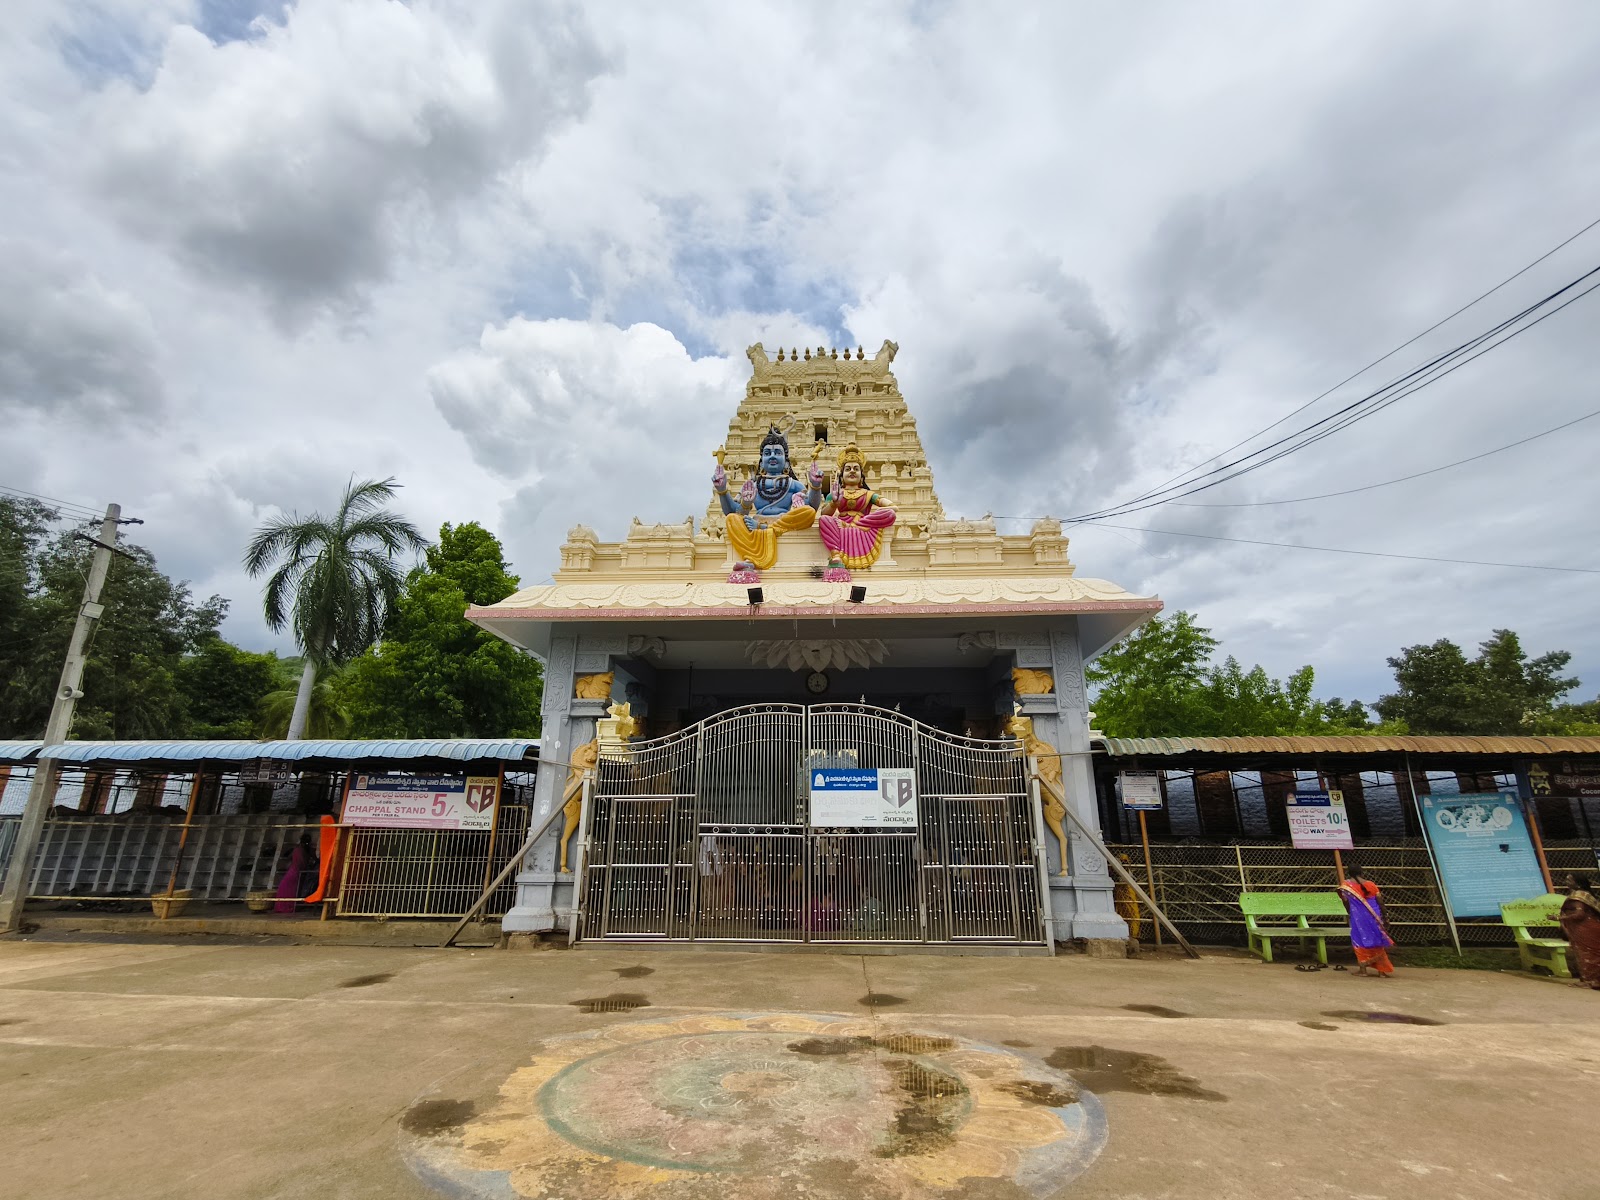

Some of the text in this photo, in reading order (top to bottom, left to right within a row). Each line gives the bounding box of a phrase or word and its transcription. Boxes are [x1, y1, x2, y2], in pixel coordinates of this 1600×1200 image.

[276, 771, 287, 779] 10
[466, 785, 496, 813] CB
[882, 778, 912, 808] CB
[348, 805, 427, 814] CHAPPAL STAND
